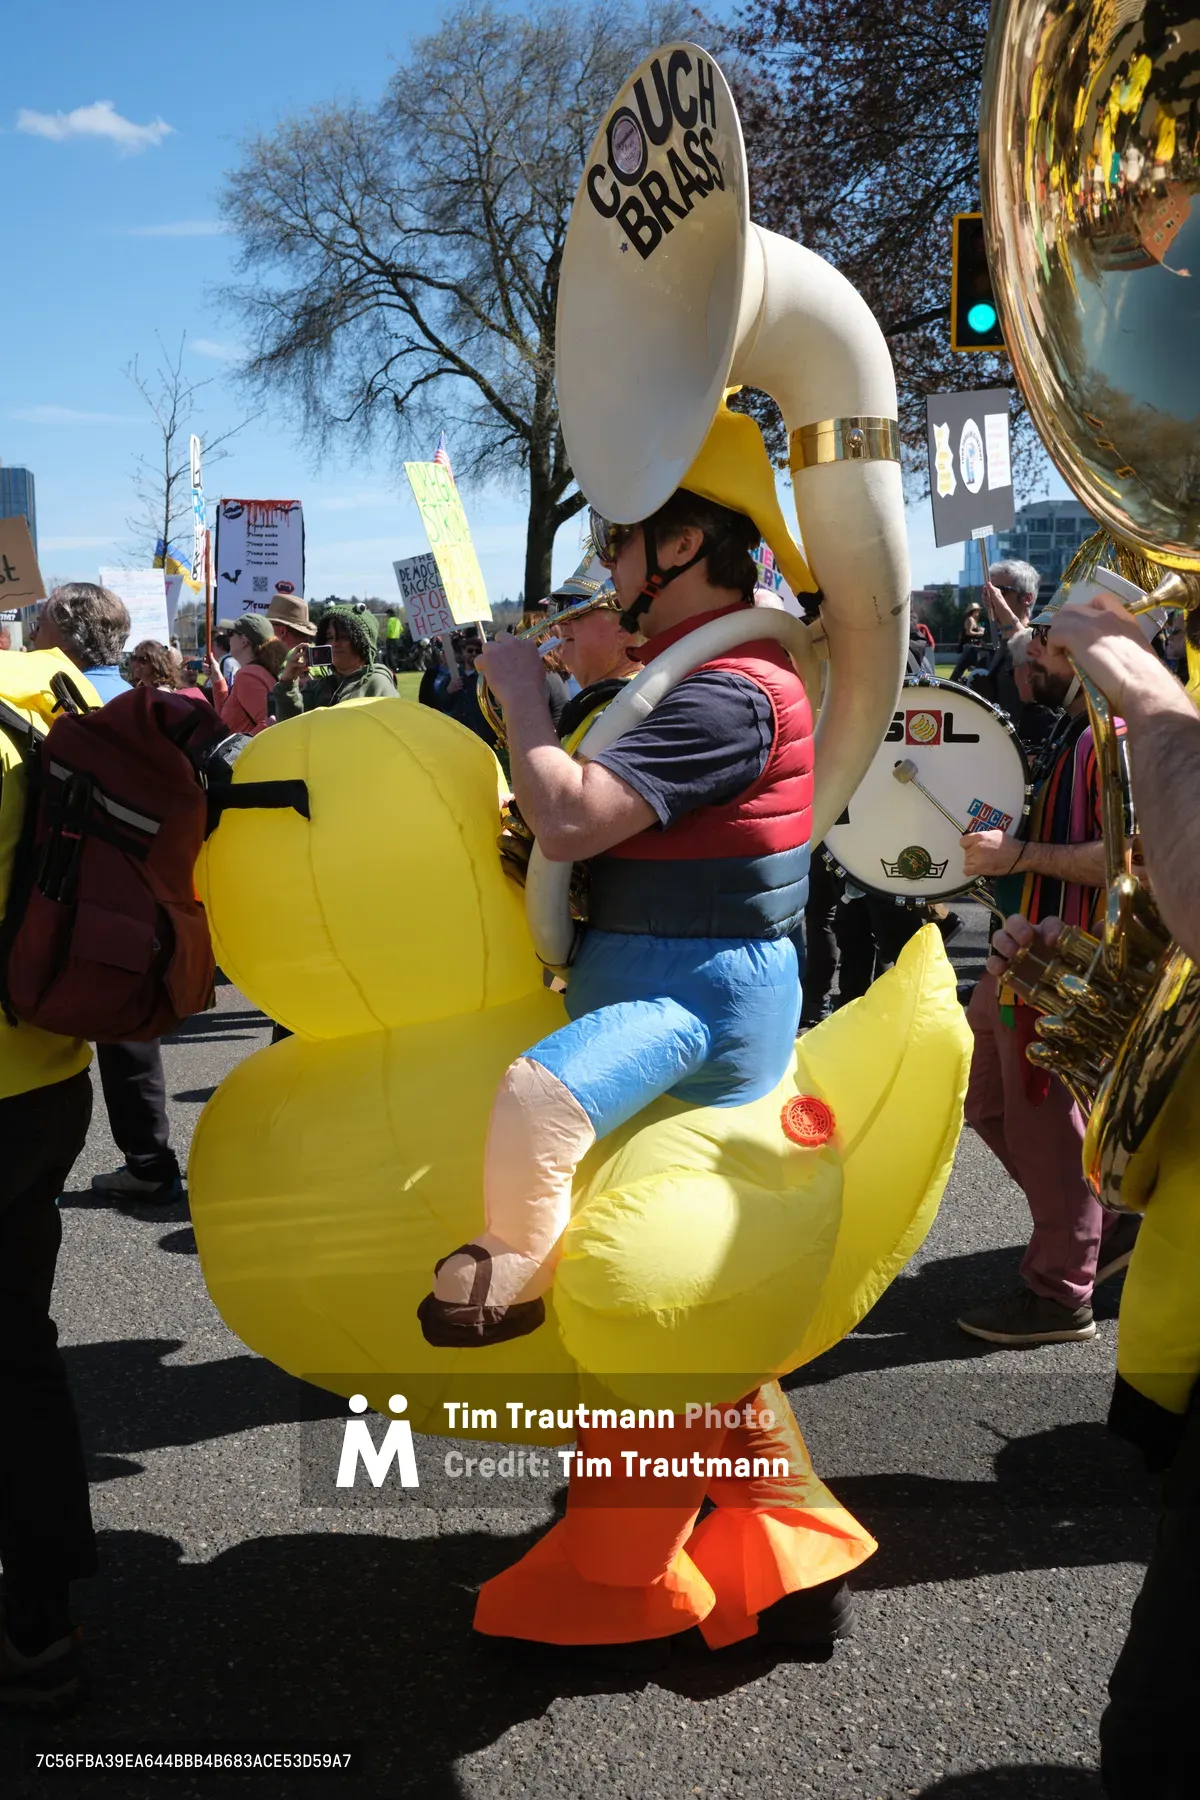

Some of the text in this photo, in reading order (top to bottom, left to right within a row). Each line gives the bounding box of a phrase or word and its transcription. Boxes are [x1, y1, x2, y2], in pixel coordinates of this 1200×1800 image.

[587, 50, 716, 218] COUCH
[616, 127, 725, 260] BRASS
[410, 552, 434, 564] THE
[414, 610, 458, 637] HER
[969, 800, 1012, 831] FUCK
